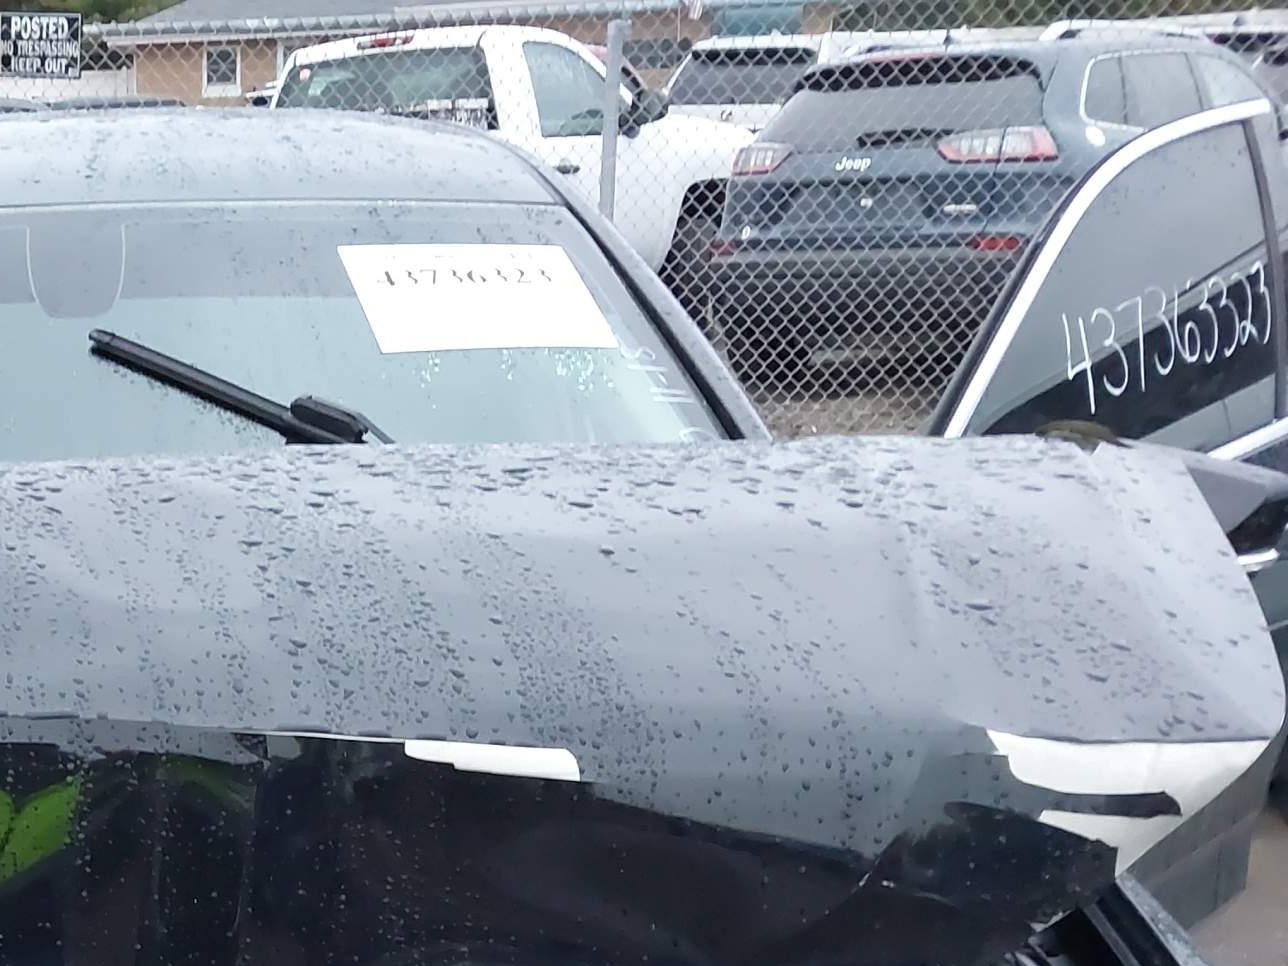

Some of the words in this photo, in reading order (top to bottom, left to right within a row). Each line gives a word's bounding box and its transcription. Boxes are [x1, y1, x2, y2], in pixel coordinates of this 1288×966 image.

[12, 16, 69, 39] POSTED
[0, 40, 13, 56] NO
[17, 39, 79, 57] TRESPASSING
[12, 57, 41, 73] KEEP
[44, 57, 68, 74] OUT
[835, 156, 872, 172] Jeep
